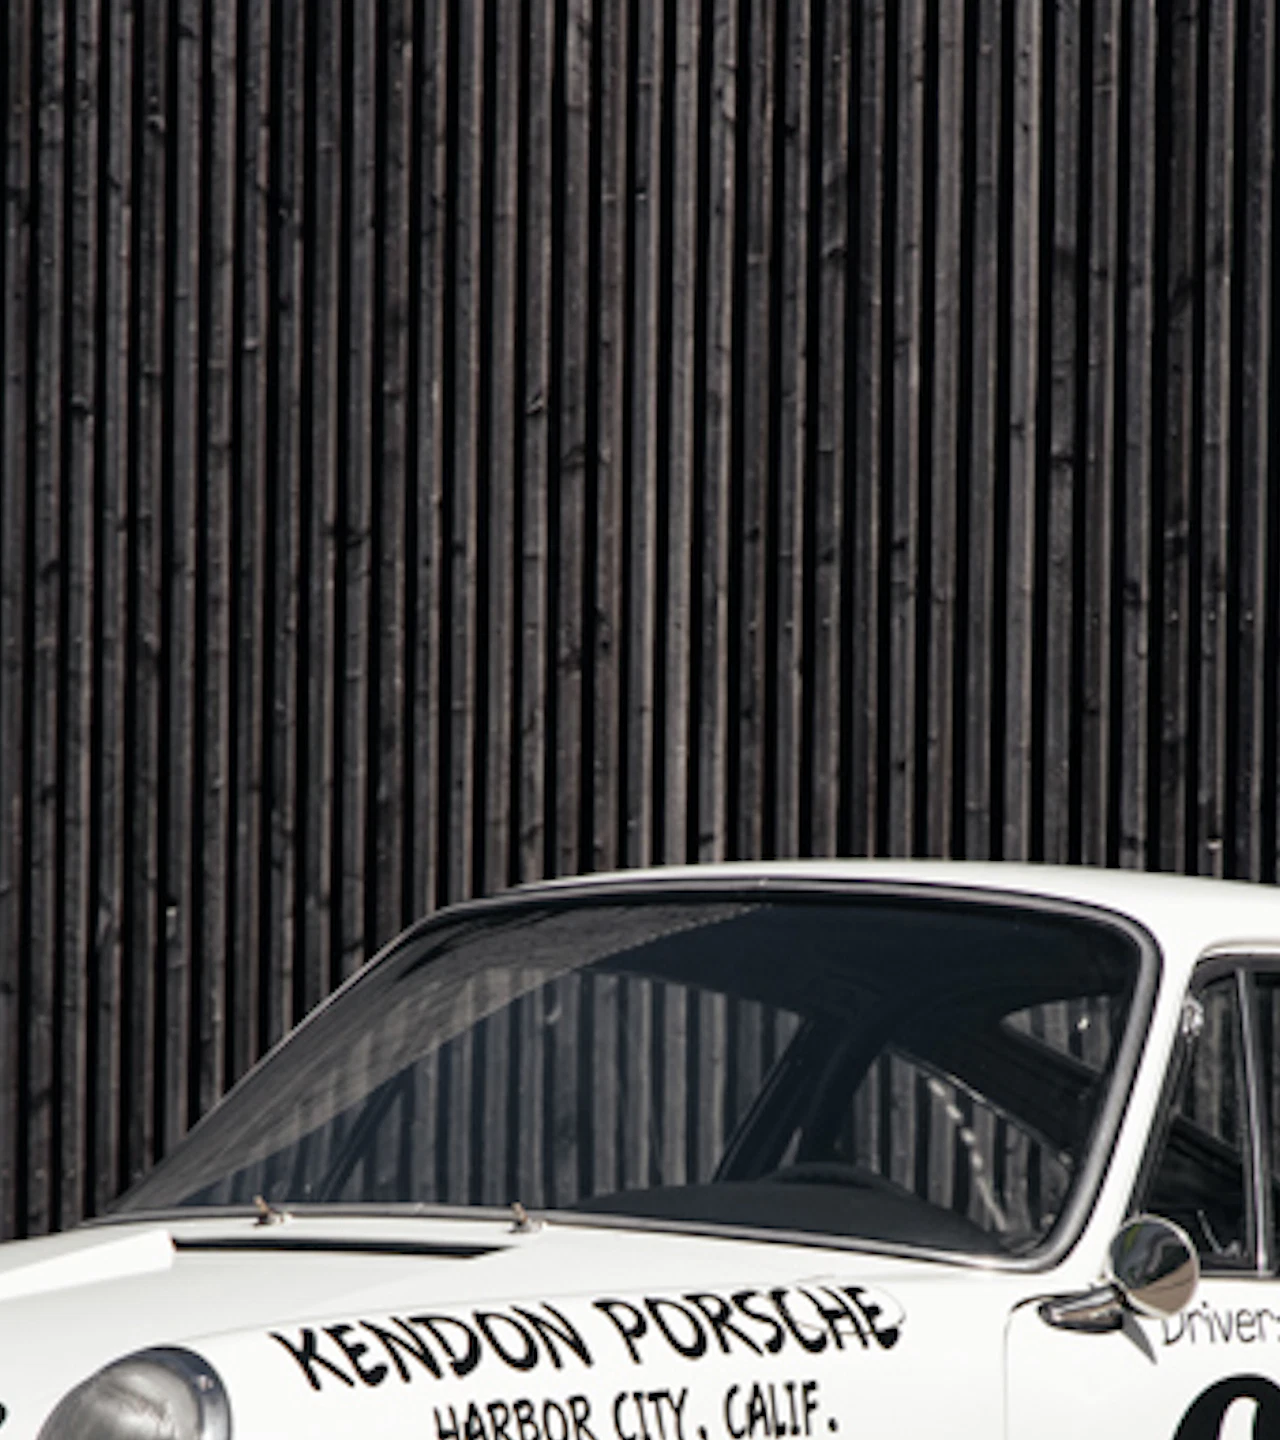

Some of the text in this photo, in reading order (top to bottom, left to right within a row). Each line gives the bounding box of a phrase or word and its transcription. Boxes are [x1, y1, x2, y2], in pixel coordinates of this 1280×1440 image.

[269, 1286, 901, 1391] KENDON PORSCHE
[724, 1380, 839, 1440] CALIF.
